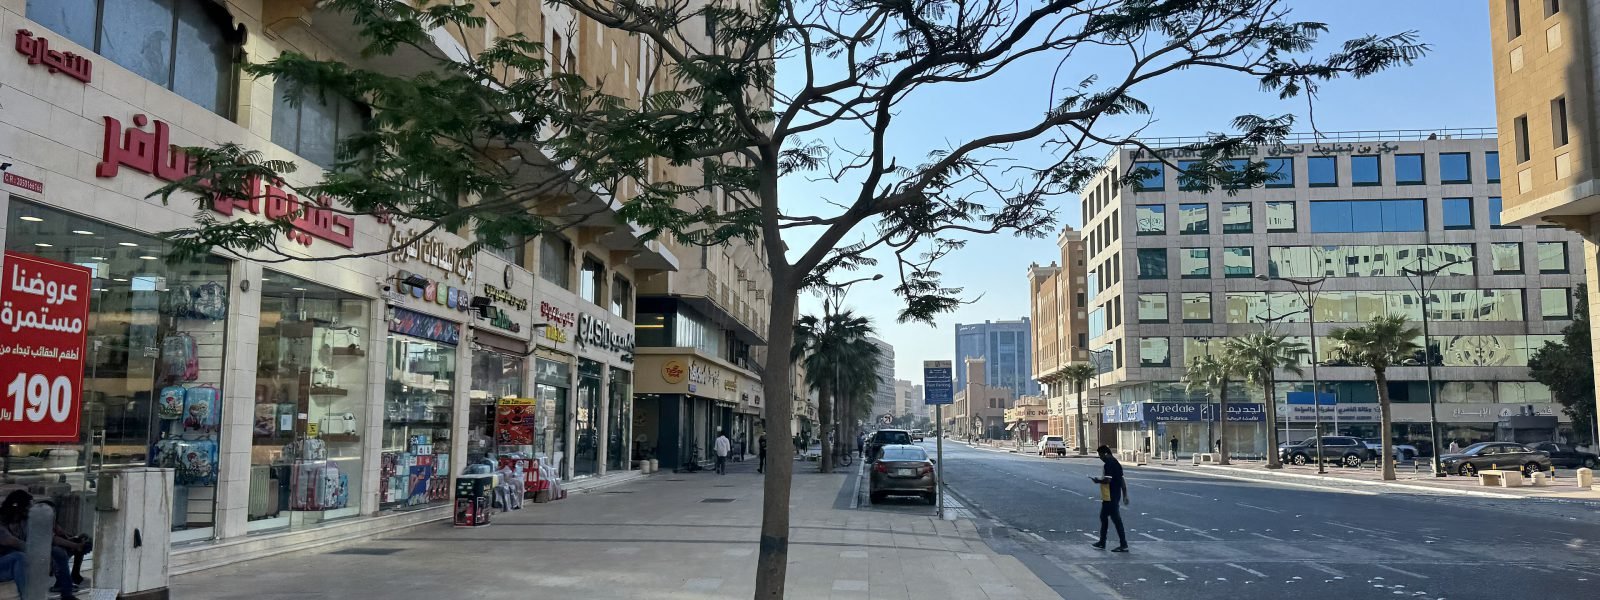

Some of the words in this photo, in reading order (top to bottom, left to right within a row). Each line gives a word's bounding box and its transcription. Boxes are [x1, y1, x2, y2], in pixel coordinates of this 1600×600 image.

[15, 28, 93, 84] للتجارة
[1357, 144, 1372, 154] بن
[1376, 141, 1399, 153] مركز
[265, 176, 354, 250] حقيبة
[11, 263, 78, 305] عروضنا
[0, 301, 83, 334] مستمرة
[577, 312, 610, 350] CASIO
[0, 344, 11, 356] من
[12, 344, 30, 358] تبداء
[31, 346, 59, 359] الحقائب
[59, 346, 80, 363] أطقم
[7, 372, 73, 423] 190
